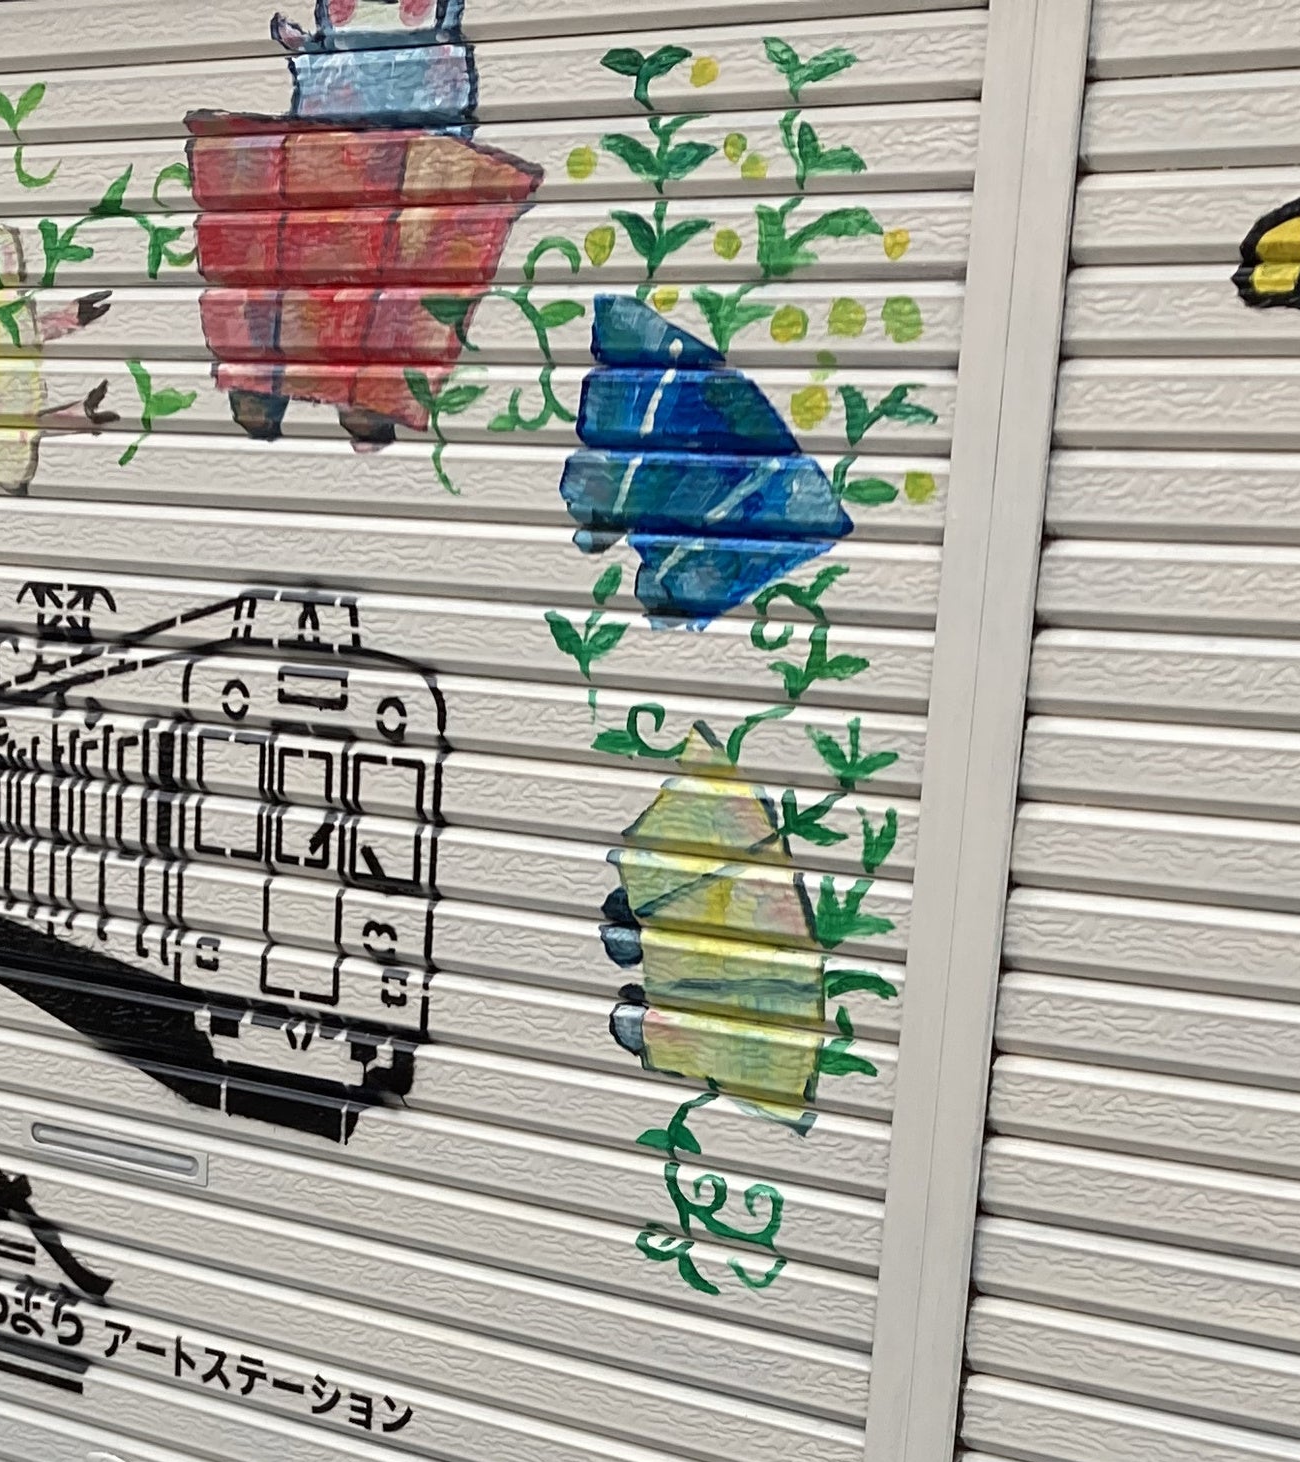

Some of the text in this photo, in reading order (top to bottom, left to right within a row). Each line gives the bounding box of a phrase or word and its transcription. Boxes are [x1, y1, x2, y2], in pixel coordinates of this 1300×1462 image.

[104, 1320, 413, 1432] アートステーション
